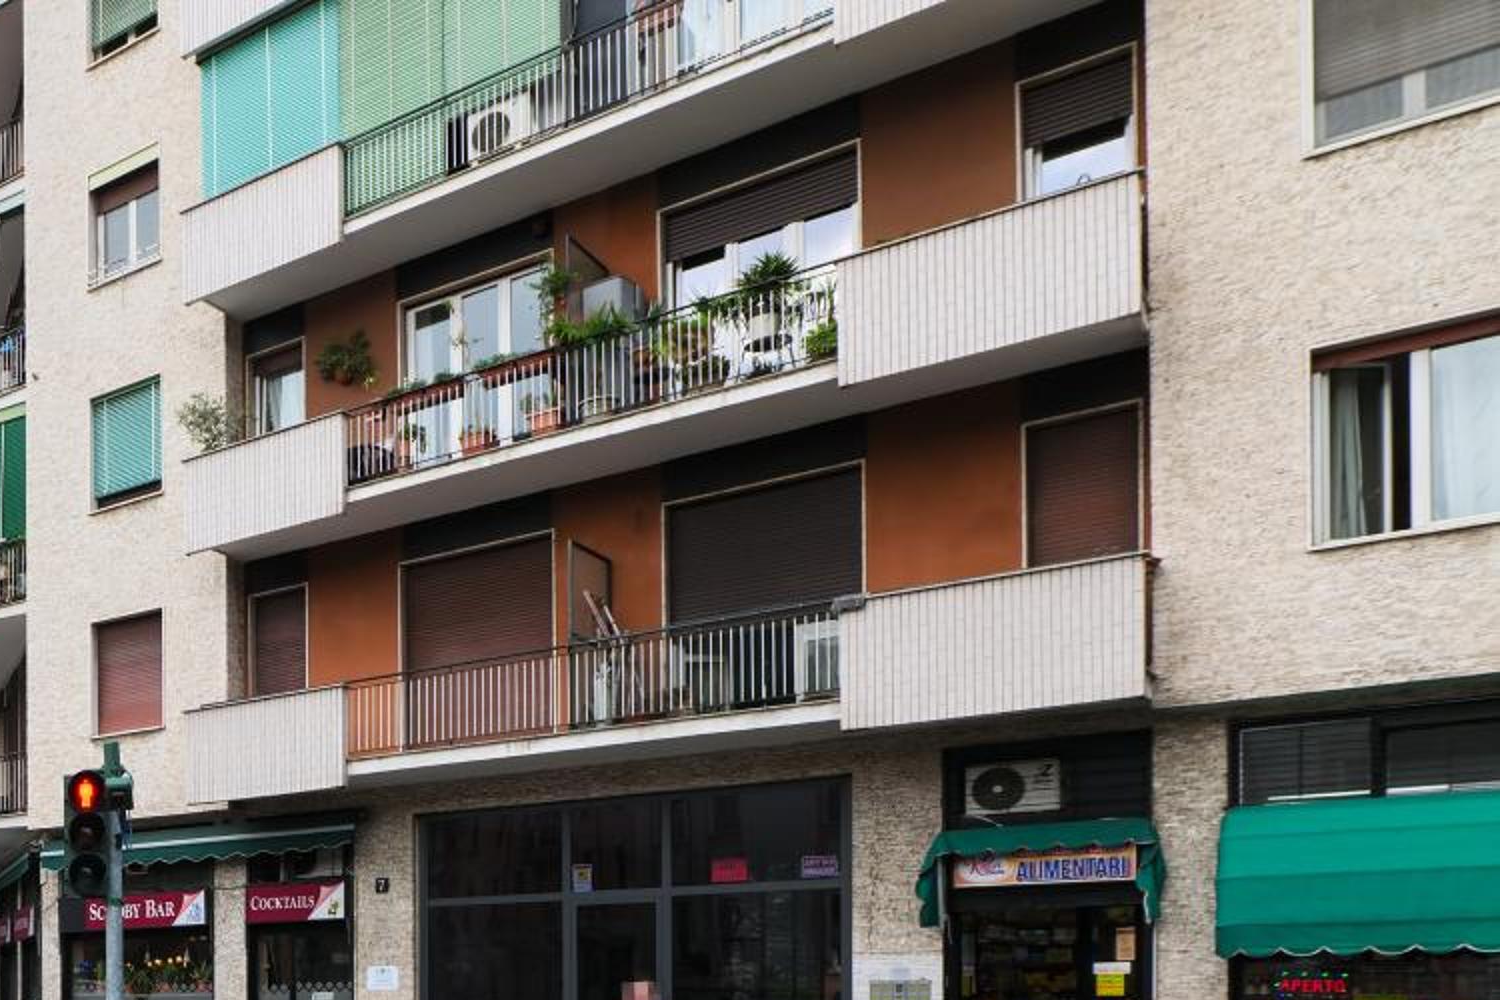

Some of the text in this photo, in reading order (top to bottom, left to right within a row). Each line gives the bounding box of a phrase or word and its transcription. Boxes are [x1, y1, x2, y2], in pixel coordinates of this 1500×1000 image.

[1016, 857, 1125, 882] ALIMENTARI
[145, 899, 175, 918] BAR
[251, 895, 315, 910] COCKTAILS
[1280, 977, 1347, 993] APERTO
